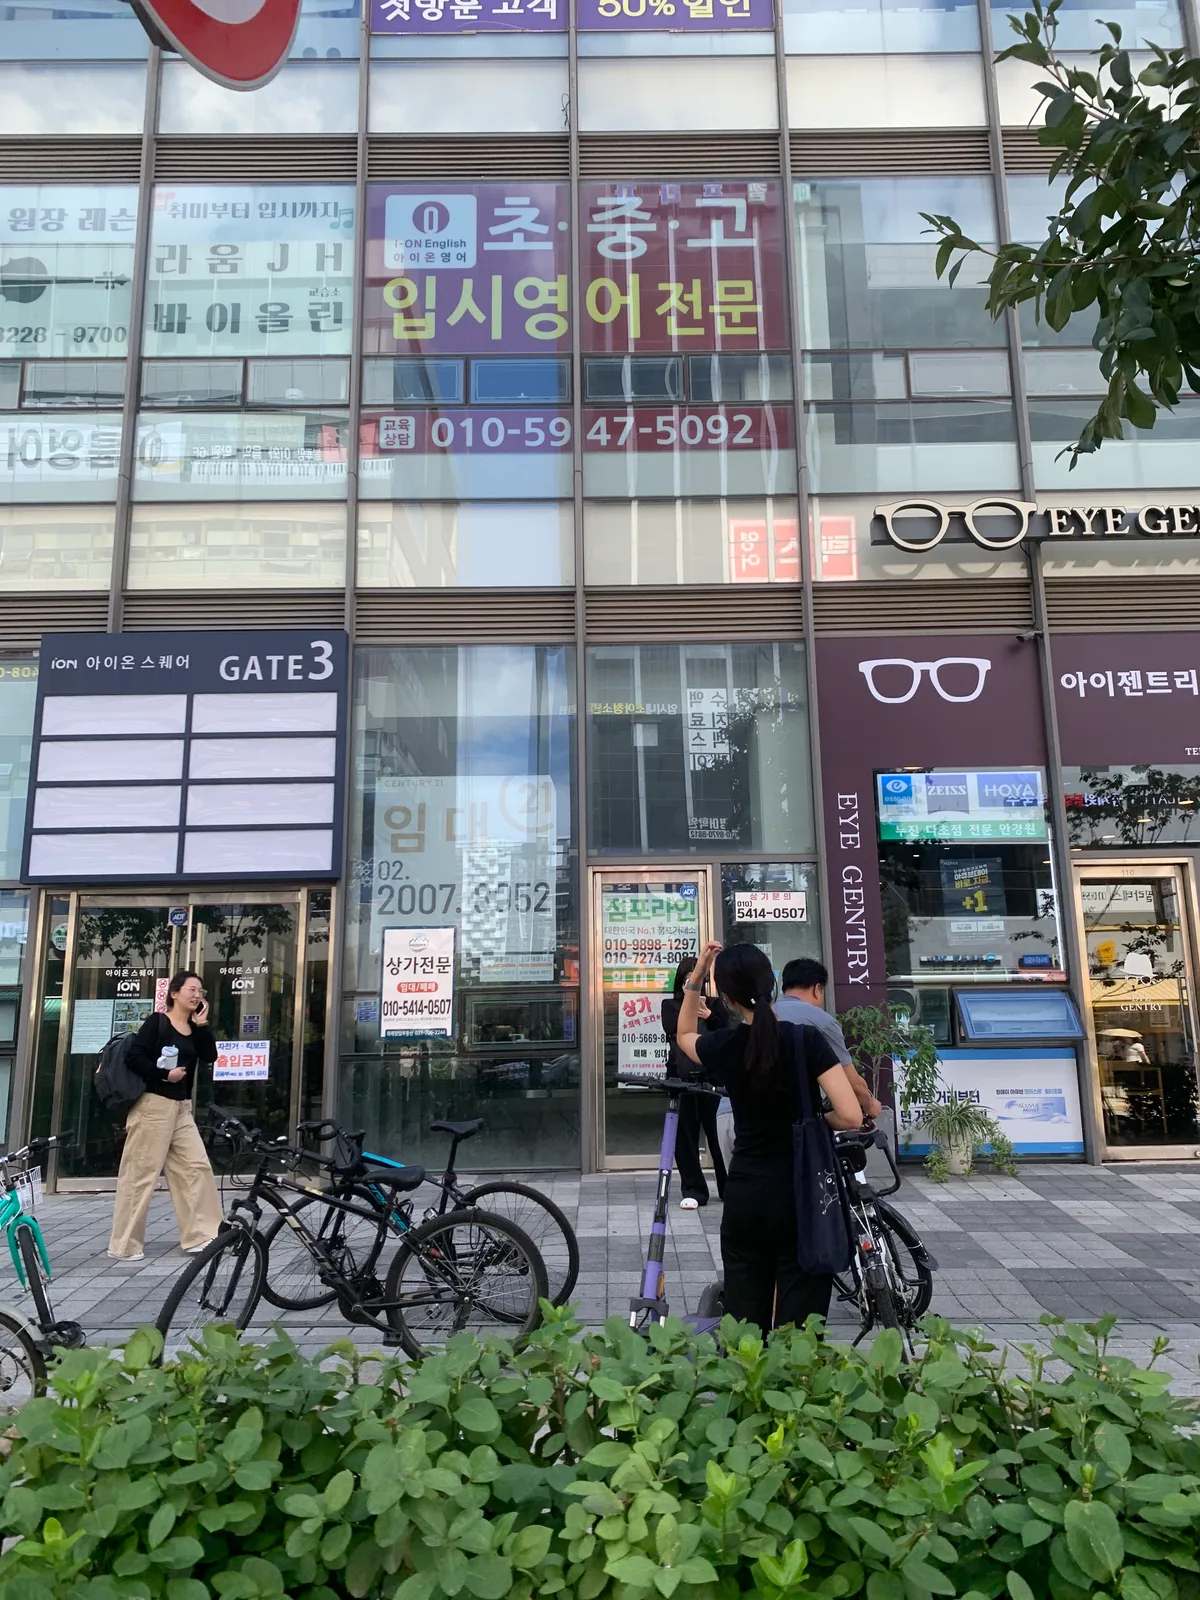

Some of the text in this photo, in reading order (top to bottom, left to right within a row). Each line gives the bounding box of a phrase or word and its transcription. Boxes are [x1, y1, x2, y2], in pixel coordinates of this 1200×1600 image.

[168, 201, 339, 219] 취미부터 입시까지
[8, 207, 136, 232] 원장 레슨
[425, 239, 467, 249] English
[393, 252, 467, 263] 아이온영어
[308, 287, 340, 297] 교습소
[383, 273, 762, 341] 입시영어 전문
[153, 301, 343, 334] 바이올린
[384, 419, 410, 432] 교육
[384, 433, 410, 446] 상담
[1047, 504, 1200, 536] EYE GE
[86, 655, 135, 671] 아이온
[140, 655, 190, 670] 스퀘어
[1060, 669, 1199, 697] 아이젠트리
[1185, 747, 1200, 756] TE
[385, 779, 444, 787] CENTURY 21
[518, 781, 551, 813] 21
[927, 785, 967, 796] ZEISS
[983, 784, 1035, 797] HOYA
[837, 792, 861, 849] EYE
[969, 824, 992, 836] 전문
[1000, 823, 1036, 836] 안경원
[378, 860, 410, 881] 02.
[962, 889, 988, 912] +1
[737, 908, 805, 918] 5414-0507
[604, 926, 635, 935] 대한민국
[842, 865, 870, 990] GENTRY
[604, 938, 696, 950] 010-9898-1297
[220, 967, 243, 975] 아이온
[386, 956, 451, 976] 상가전문
[105, 969, 129, 977] 아이온
[383, 999, 451, 1017] 010-5414-0507
[623, 997, 652, 1017] 상가
[1121, 1003, 1163, 1011] GENTRY
[622, 1033, 666, 1043] 010-5669-8
[217, 1054, 267, 1067] 출입금지
